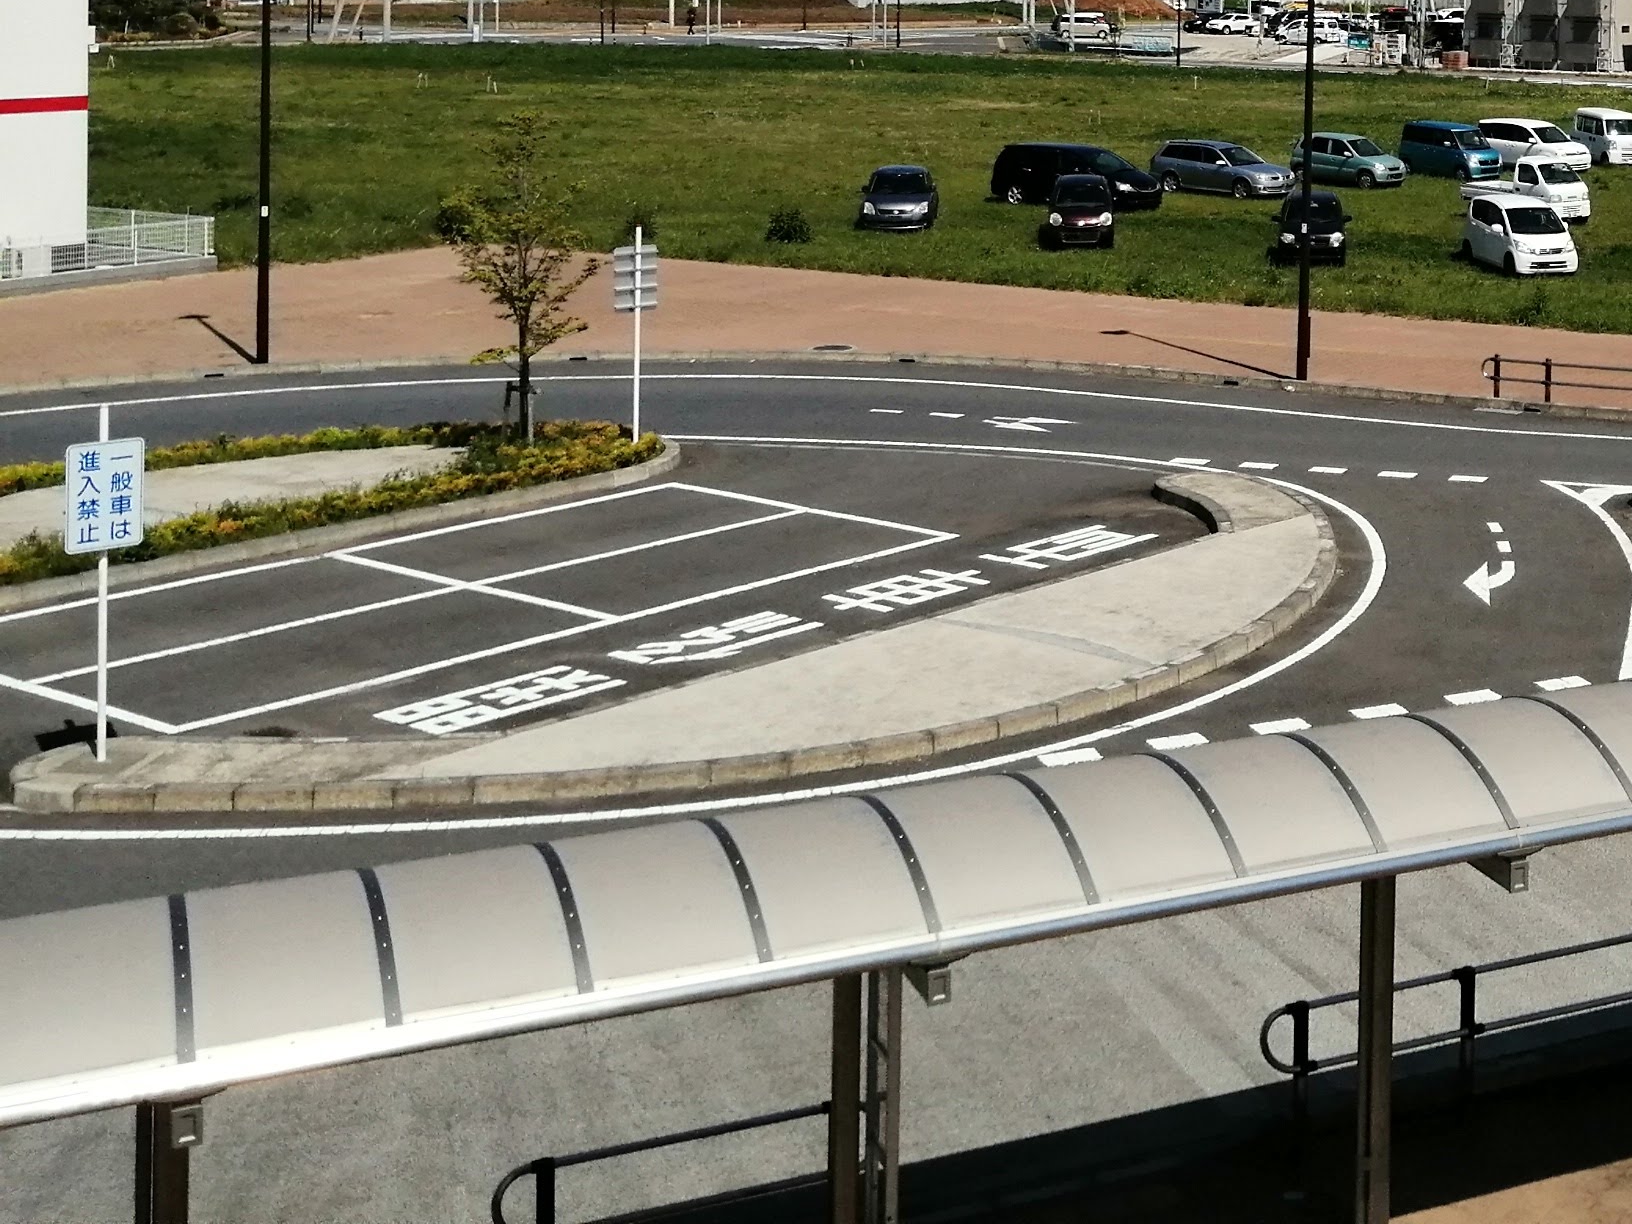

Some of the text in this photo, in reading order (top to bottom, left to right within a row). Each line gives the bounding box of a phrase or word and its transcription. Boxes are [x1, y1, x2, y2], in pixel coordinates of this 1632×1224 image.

[78, 451, 101, 544] 進入禁止
[111, 455, 133, 540] 一般車は
[372, 524, 1160, 736] 関係車両
